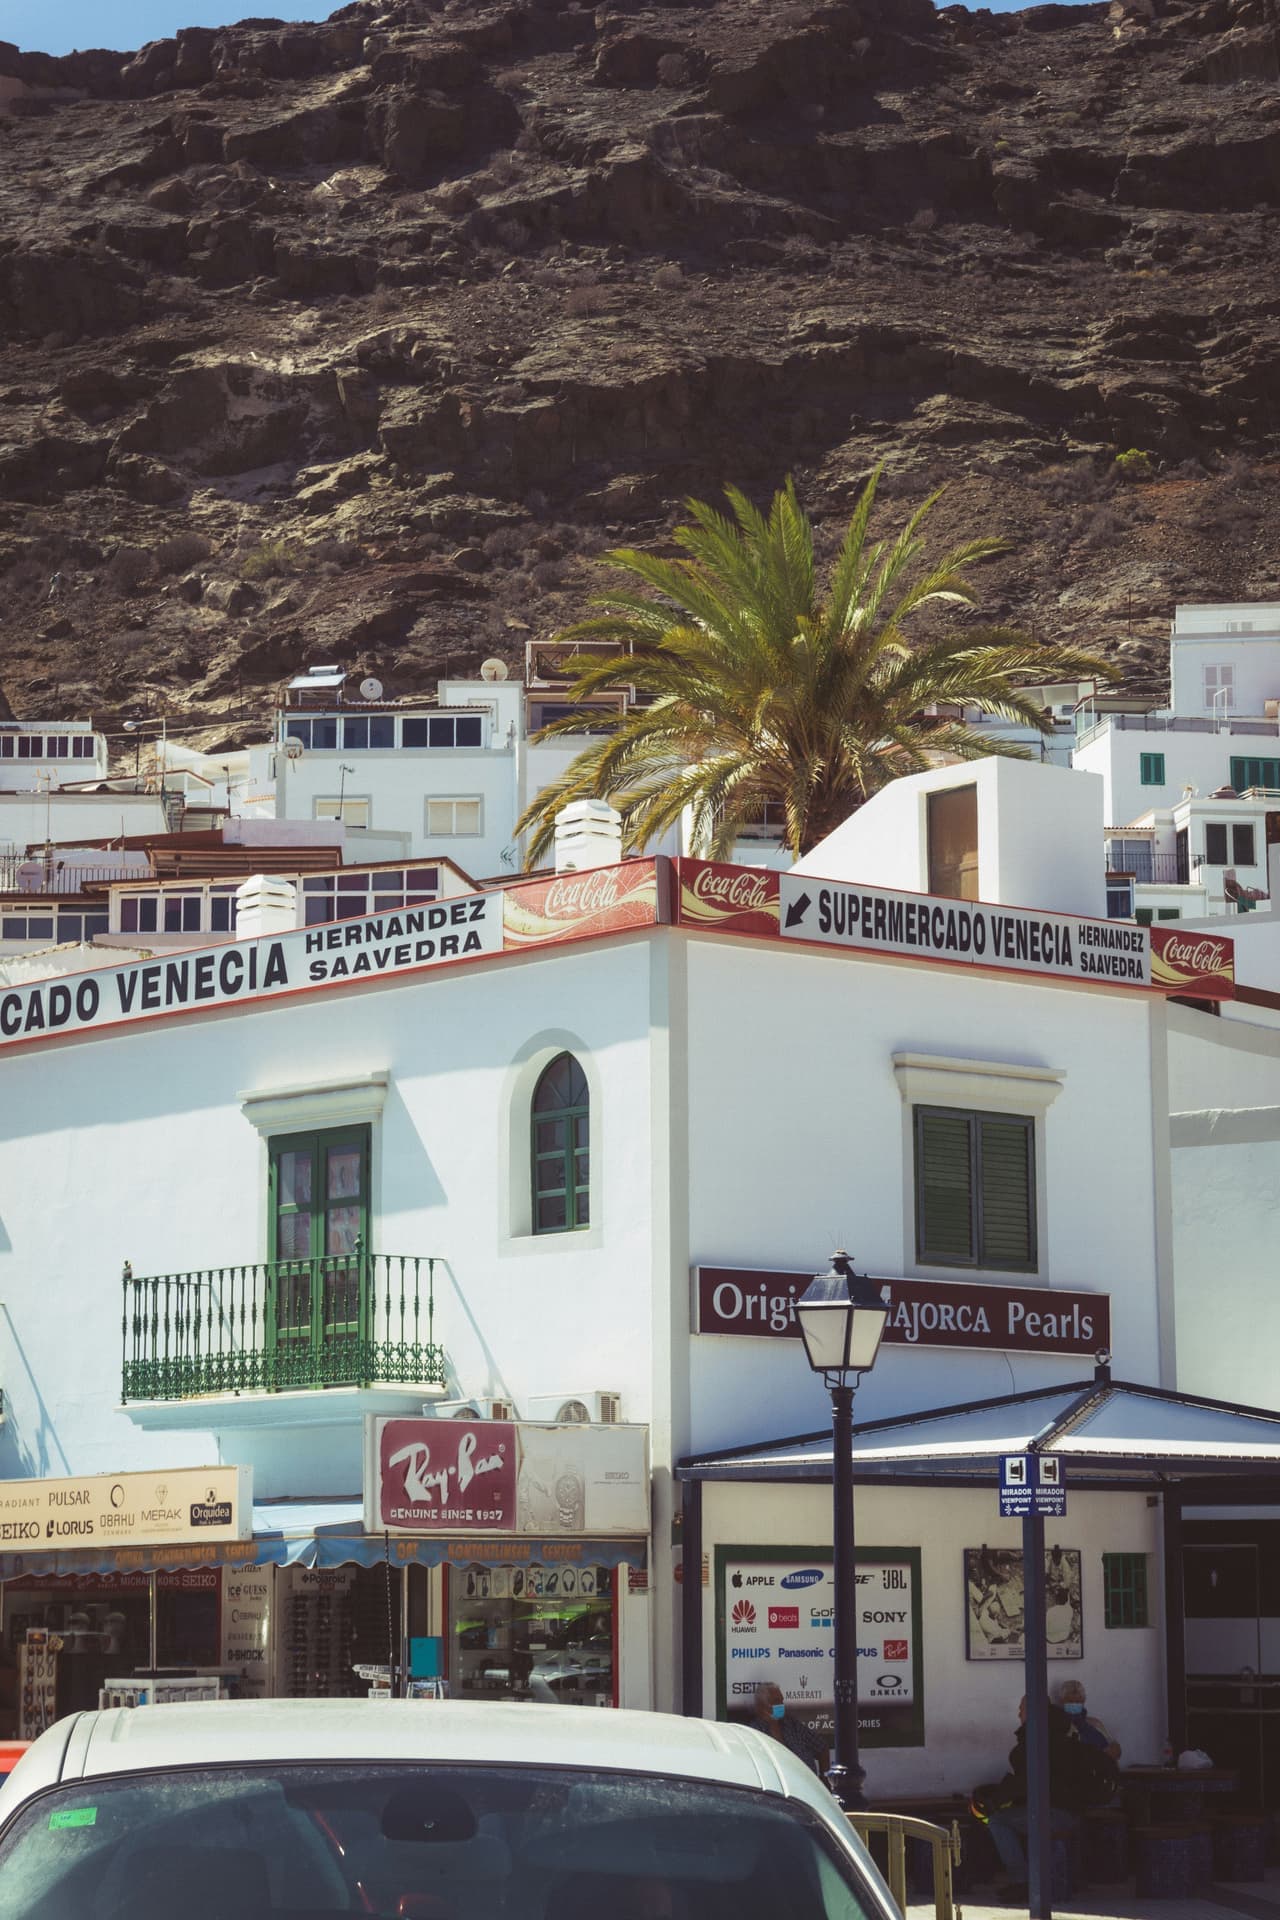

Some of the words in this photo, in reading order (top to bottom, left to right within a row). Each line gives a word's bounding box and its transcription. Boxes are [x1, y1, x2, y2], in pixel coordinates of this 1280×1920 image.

[545, 869, 619, 913] Coca-Cola
[693, 866, 769, 908] Coca-Cola
[305, 899, 486, 954] HERNANDEZ
[818, 889, 986, 955] SUPERMERCADO
[991, 916, 1073, 966] VENECIA
[1078, 923, 1144, 953] HERNANDEZ
[308, 930, 483, 982] SAAVEDRA
[1161, 936, 1225, 973] Coca-Cola
[1080, 951, 1144, 980] SAAVEDRA
[0, 979, 101, 1036] CADO
[116, 942, 289, 1013] VENECIA
[712, 1282, 800, 1331] Origi
[880, 1285, 991, 1342] AJORCA
[1008, 1302, 1094, 1341] Pearls
[48, 1490, 90, 1506] PULSAR
[1001, 1488, 1032, 1496] MIRADOR
[1036, 1488, 1064, 1496] MIRADOR
[141, 1509, 182, 1520] MERAK
[390, 1508, 438, 1520] GENUINE
[441, 1509, 473, 1520] SINCE
[476, 1510, 504, 1520] 1937
[0, 1522, 40, 1539] EIKO
[56, 1520, 94, 1536] LORUS
[158, 1576, 180, 1586] KORS
[182, 1575, 216, 1586] SEIKO
[310, 1574, 346, 1584] Polaroid
[746, 1576, 775, 1586] APPLE
[786, 1574, 820, 1584] SAMSUNG
[883, 1570, 907, 1589] JBL
[862, 1611, 907, 1623] SONY
[732, 1648, 770, 1659] PHILIPS
[778, 1647, 824, 1658] Panasonic
[732, 1682, 761, 1695] SEI
[786, 1690, 822, 1700] MASERATI
[808, 1721, 821, 1730] OF
